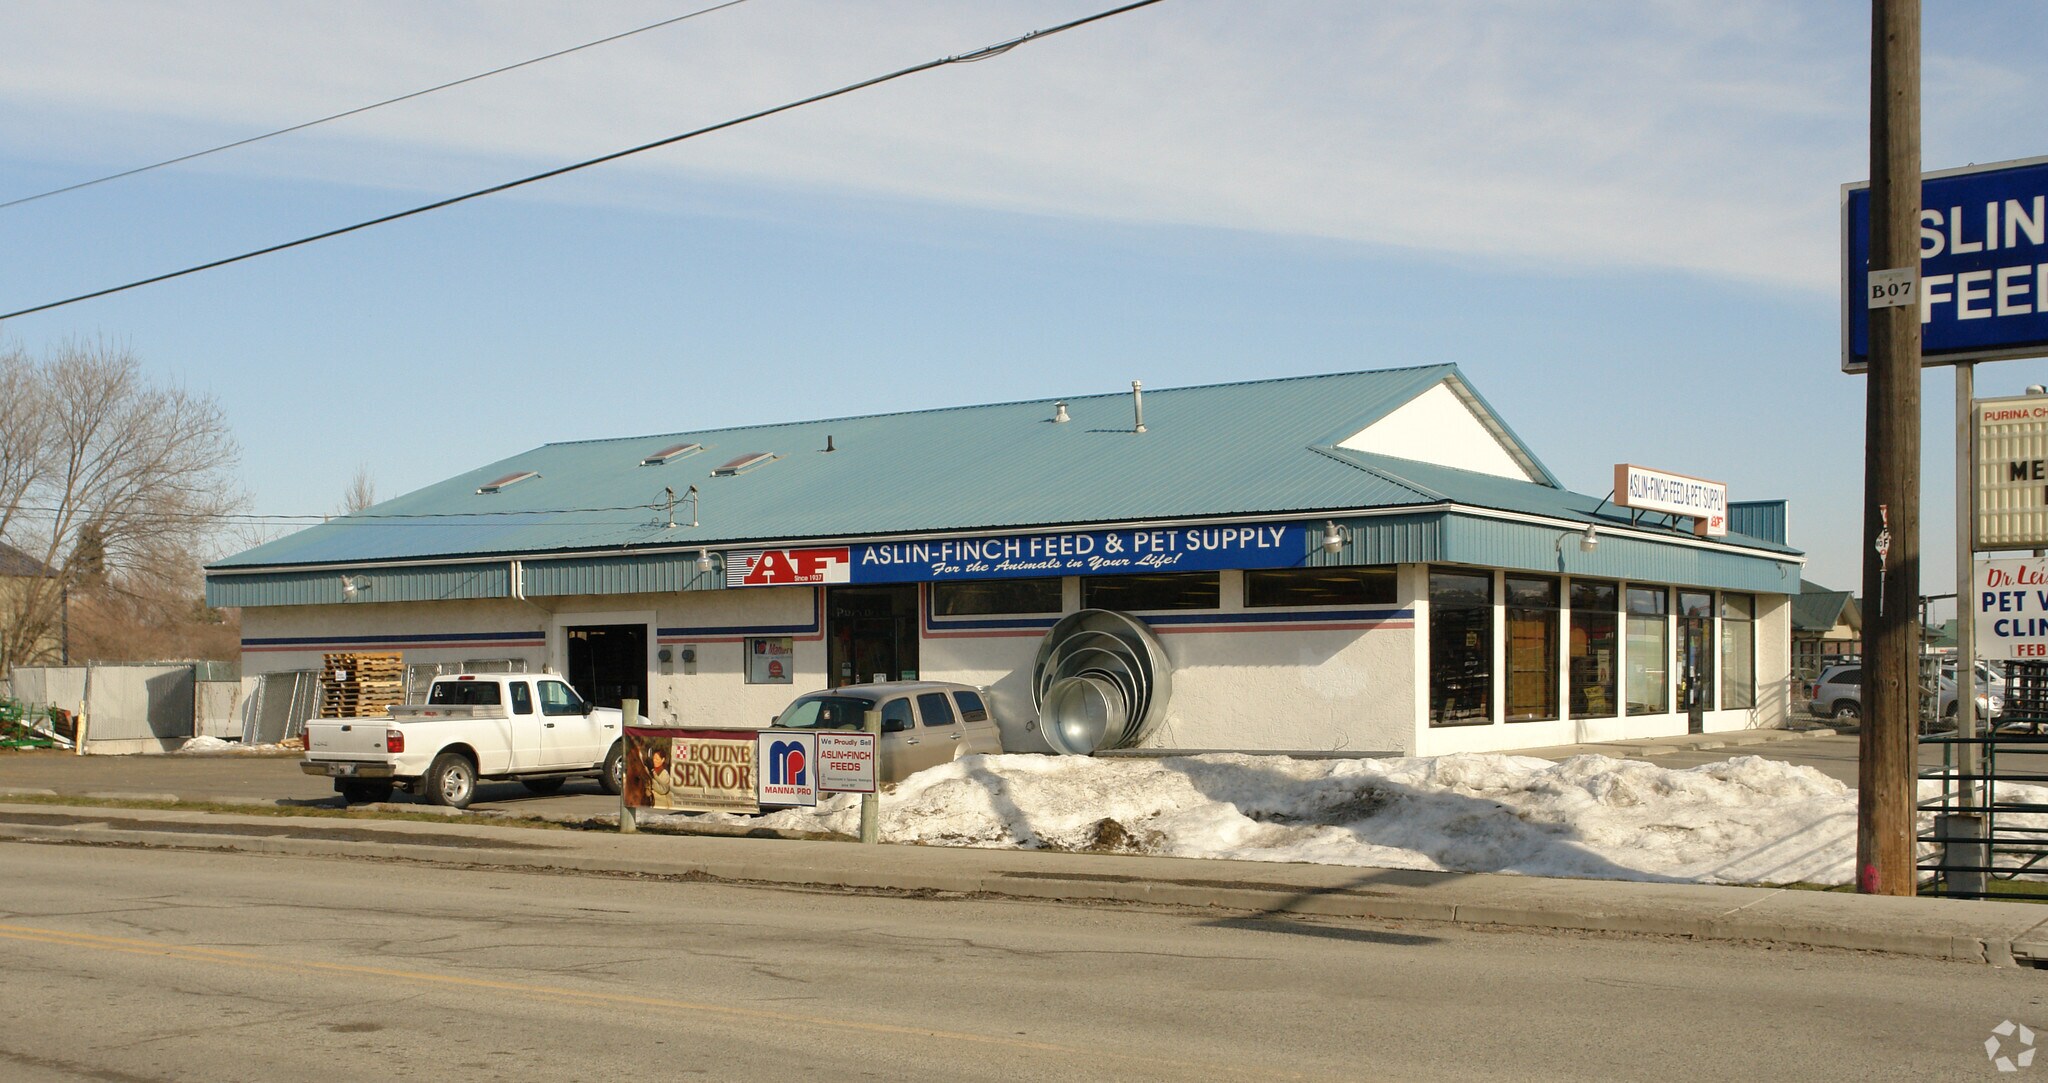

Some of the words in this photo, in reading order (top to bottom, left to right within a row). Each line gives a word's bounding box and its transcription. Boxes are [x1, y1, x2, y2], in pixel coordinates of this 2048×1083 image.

[1866, 195, 2046, 266] SLIN
[1872, 282, 1911, 299] B07
[1984, 409, 2029, 421] PURINA
[1629, 473, 1669, 502] ASLIN-FINCH
[1669, 481, 1685, 505] FEED
[1685, 483, 1690, 506] &
[1691, 484, 1702, 508] PET
[1703, 487, 1725, 511] SUPPLY
[862, 539, 1020, 565] ASLIN-FINCH
[1030, 534, 1095, 558] FEED
[1105, 533, 1124, 554] &
[1134, 530, 1179, 552] PET
[1186, 526, 1286, 551] SUPPLY
[931, 562, 961, 576] For
[965, 560, 989, 573] the
[994, 558, 1062, 572] Animals
[1066, 558, 1084, 568] in
[1087, 555, 1131, 571] Your
[1134, 552, 1183, 569] Life!
[1987, 568, 2015, 588] Dr.
[1982, 591, 2027, 613] PET
[834, 738, 857, 747] Proudly
[690, 744, 751, 764] EQUINE
[821, 750, 871, 760] ASLIN-FINCH
[673, 763, 752, 790] SENIOR
[830, 762, 860, 771] FEEDS
[764, 786, 795, 796] MANNA
[797, 787, 811, 796] PRO
